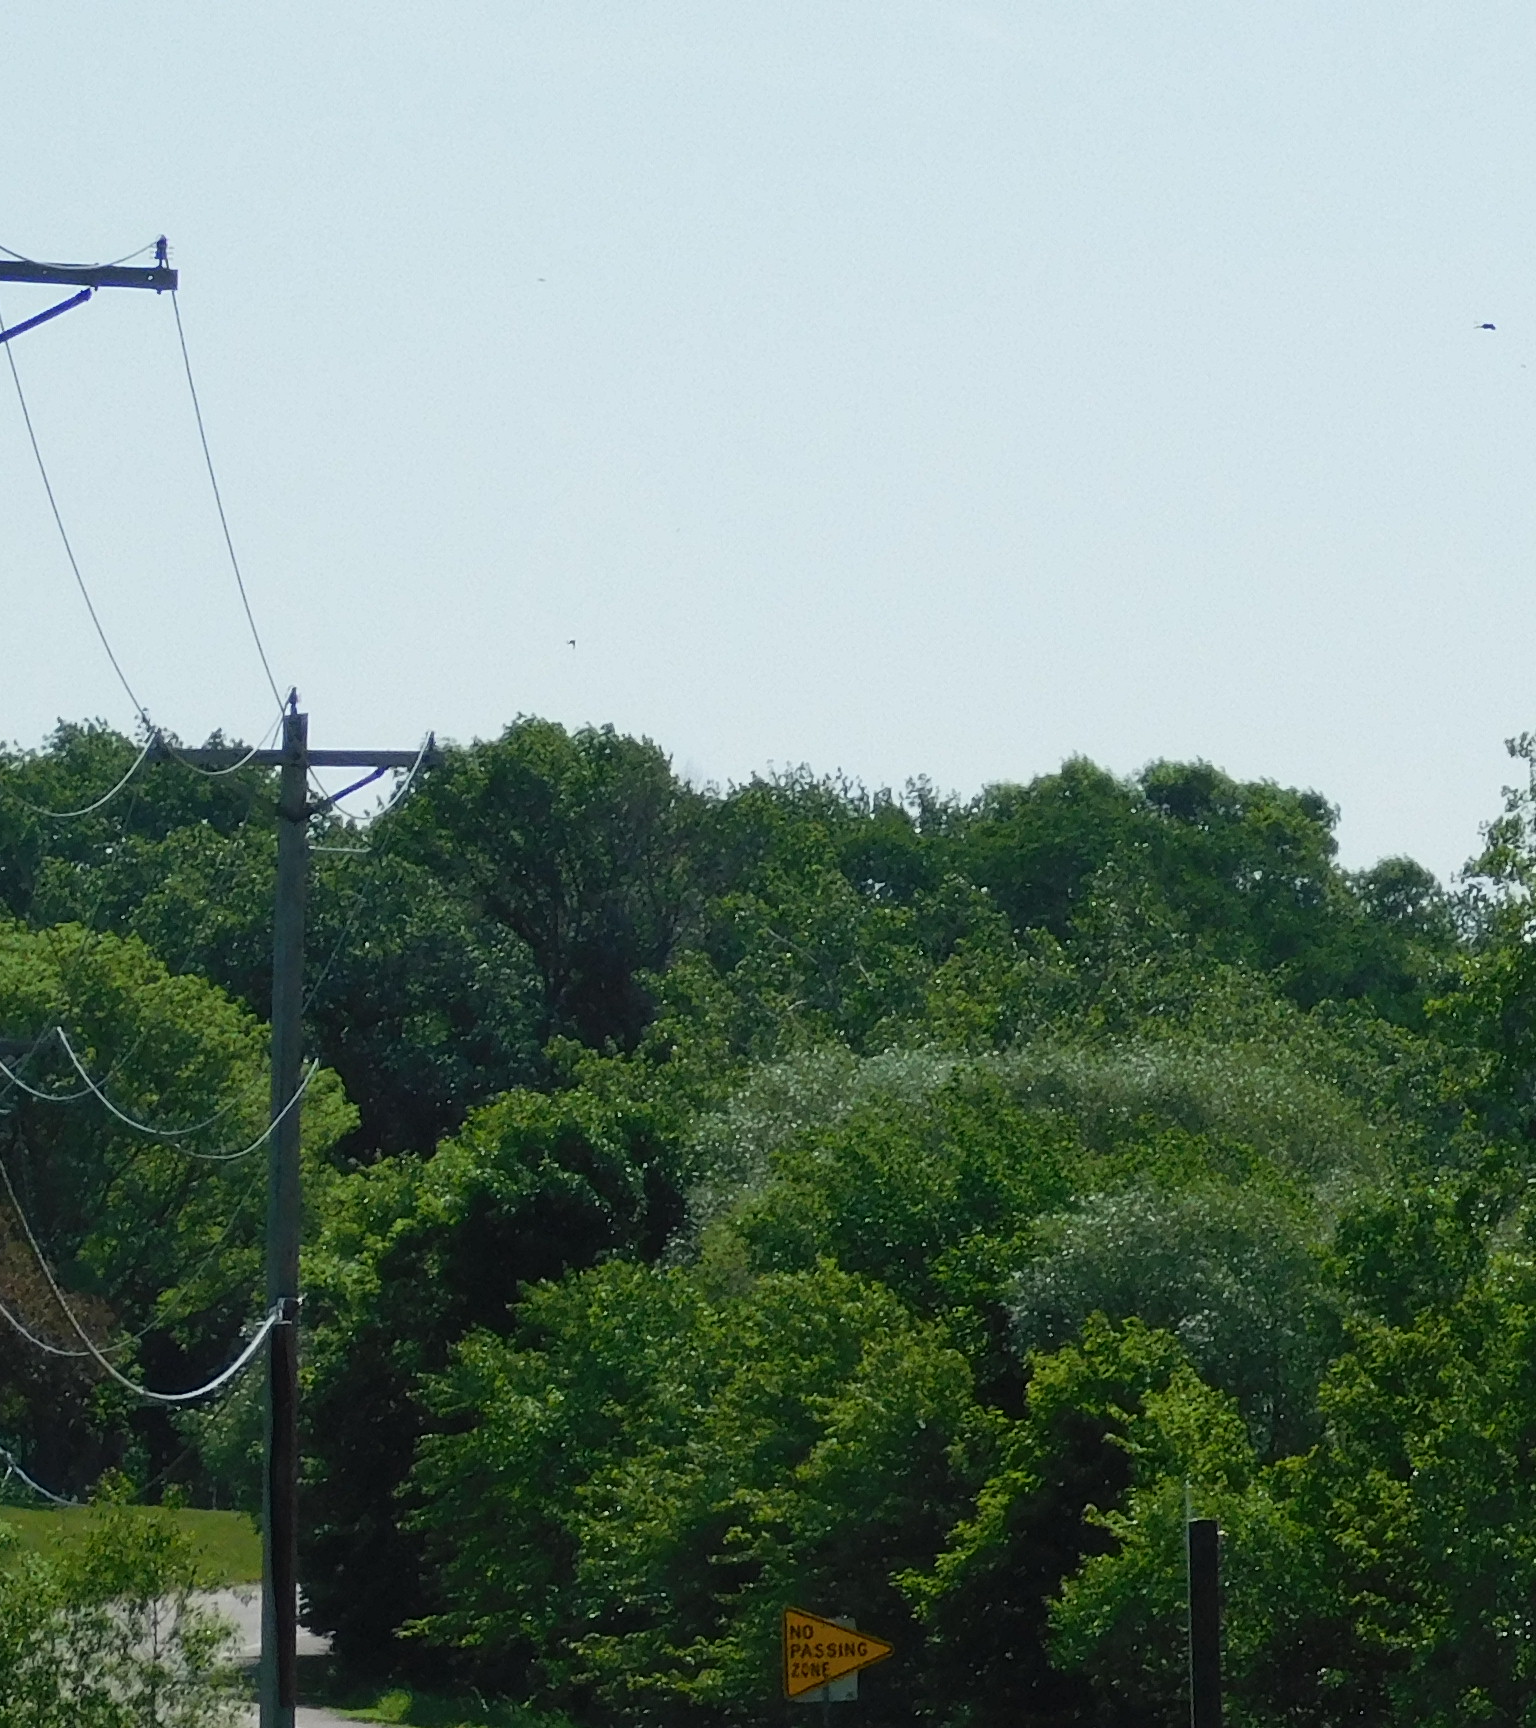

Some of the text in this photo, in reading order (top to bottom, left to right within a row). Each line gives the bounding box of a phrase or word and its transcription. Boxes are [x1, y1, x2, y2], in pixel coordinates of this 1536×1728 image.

[789, 1624, 814, 1640] NO
[789, 1642, 868, 1659] PASSING
[791, 1661, 831, 1679] ZONE
